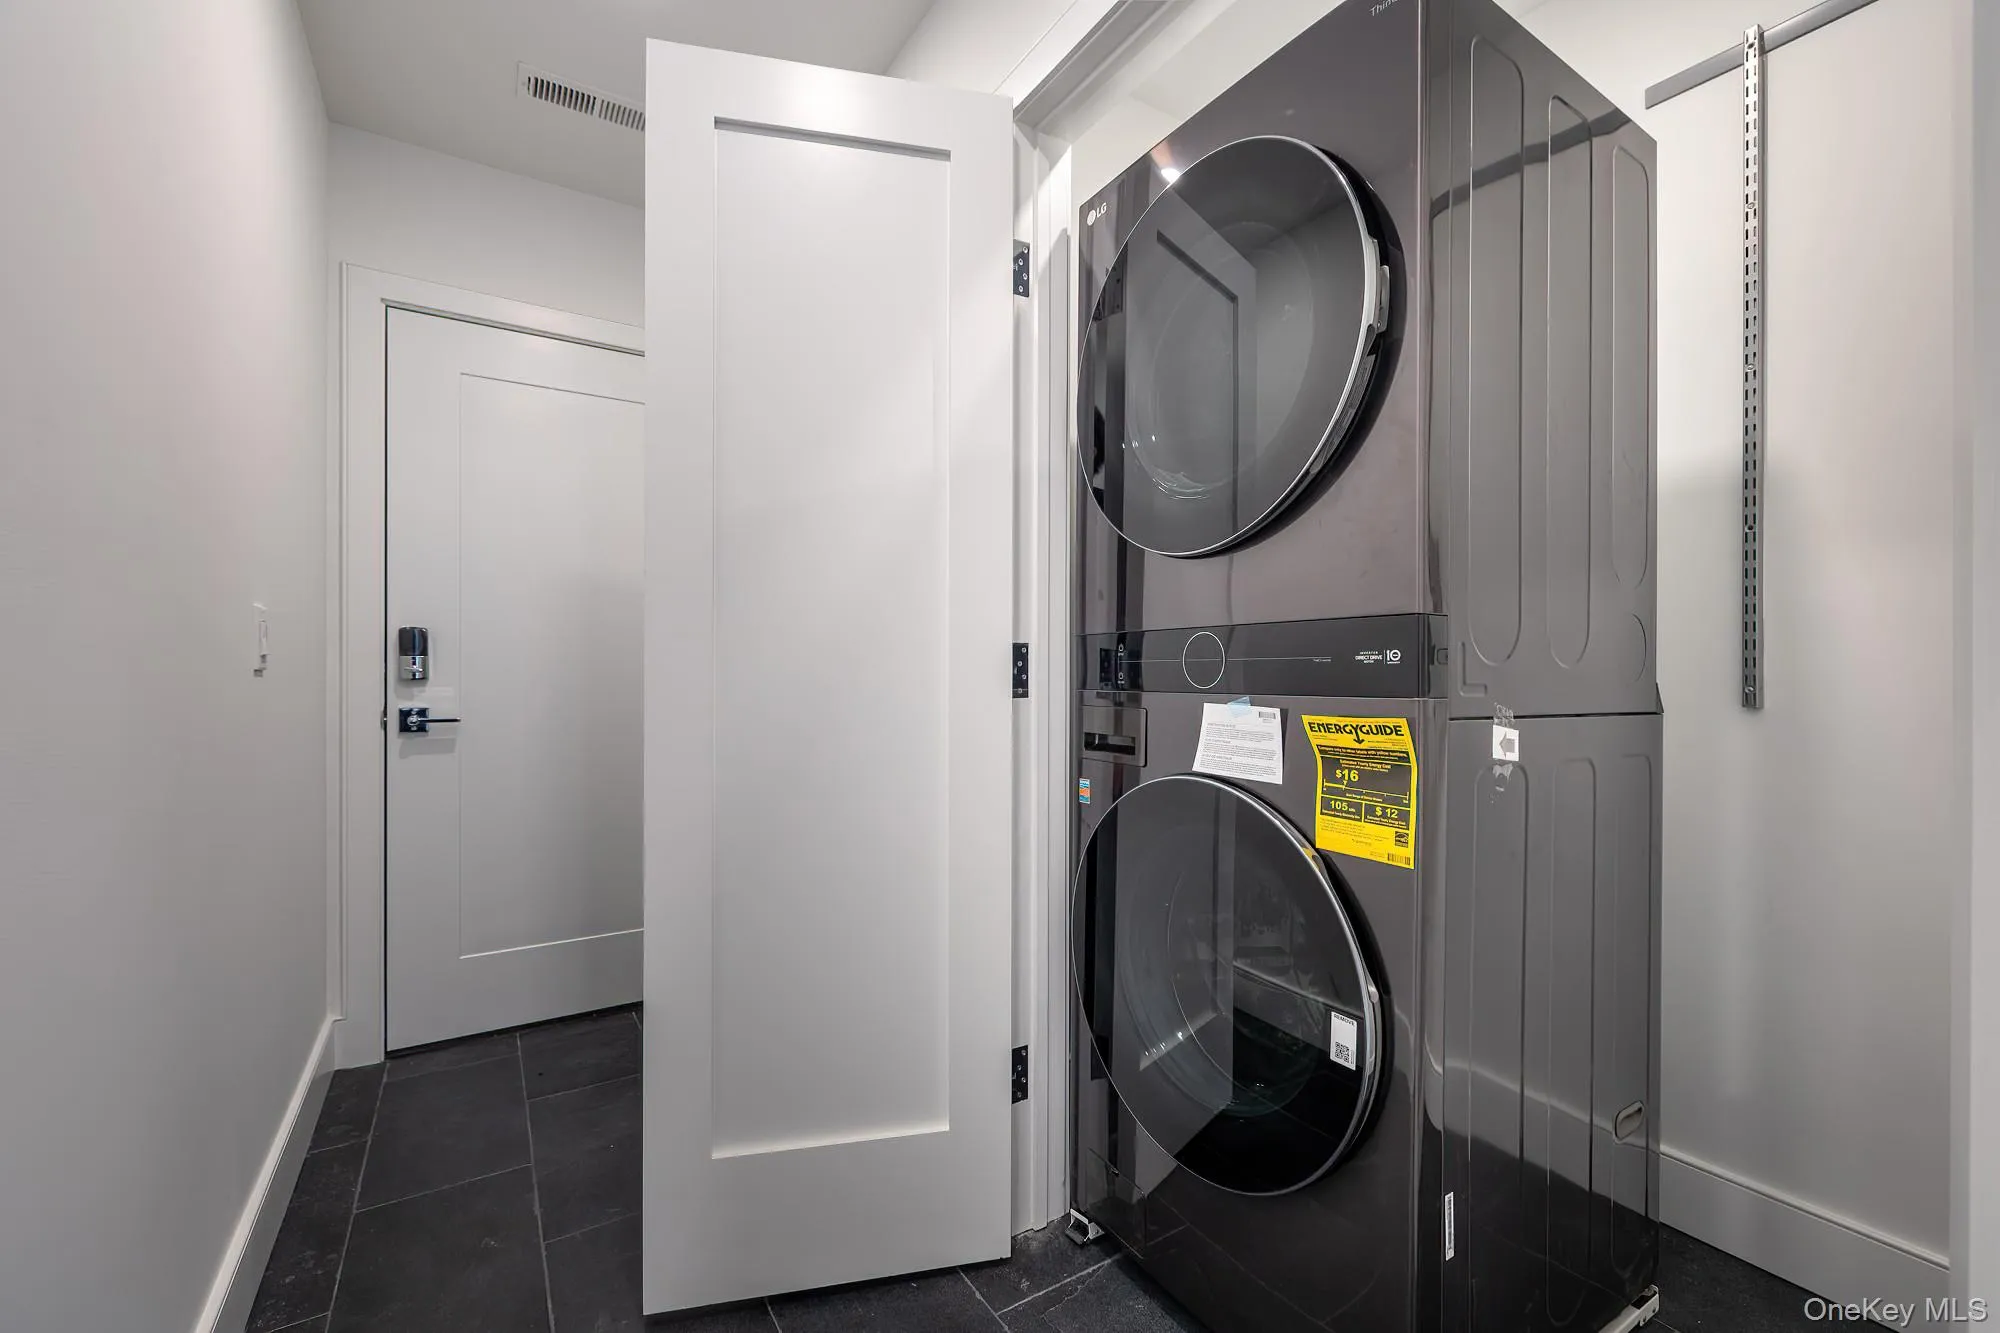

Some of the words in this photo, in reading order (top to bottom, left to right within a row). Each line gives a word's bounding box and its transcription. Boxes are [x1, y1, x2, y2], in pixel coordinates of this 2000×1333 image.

[1369, 0, 1398, 17] Thin
[1307, 721, 1405, 738] ENERGYGUIDE
[1330, 800, 1348, 811] 105
